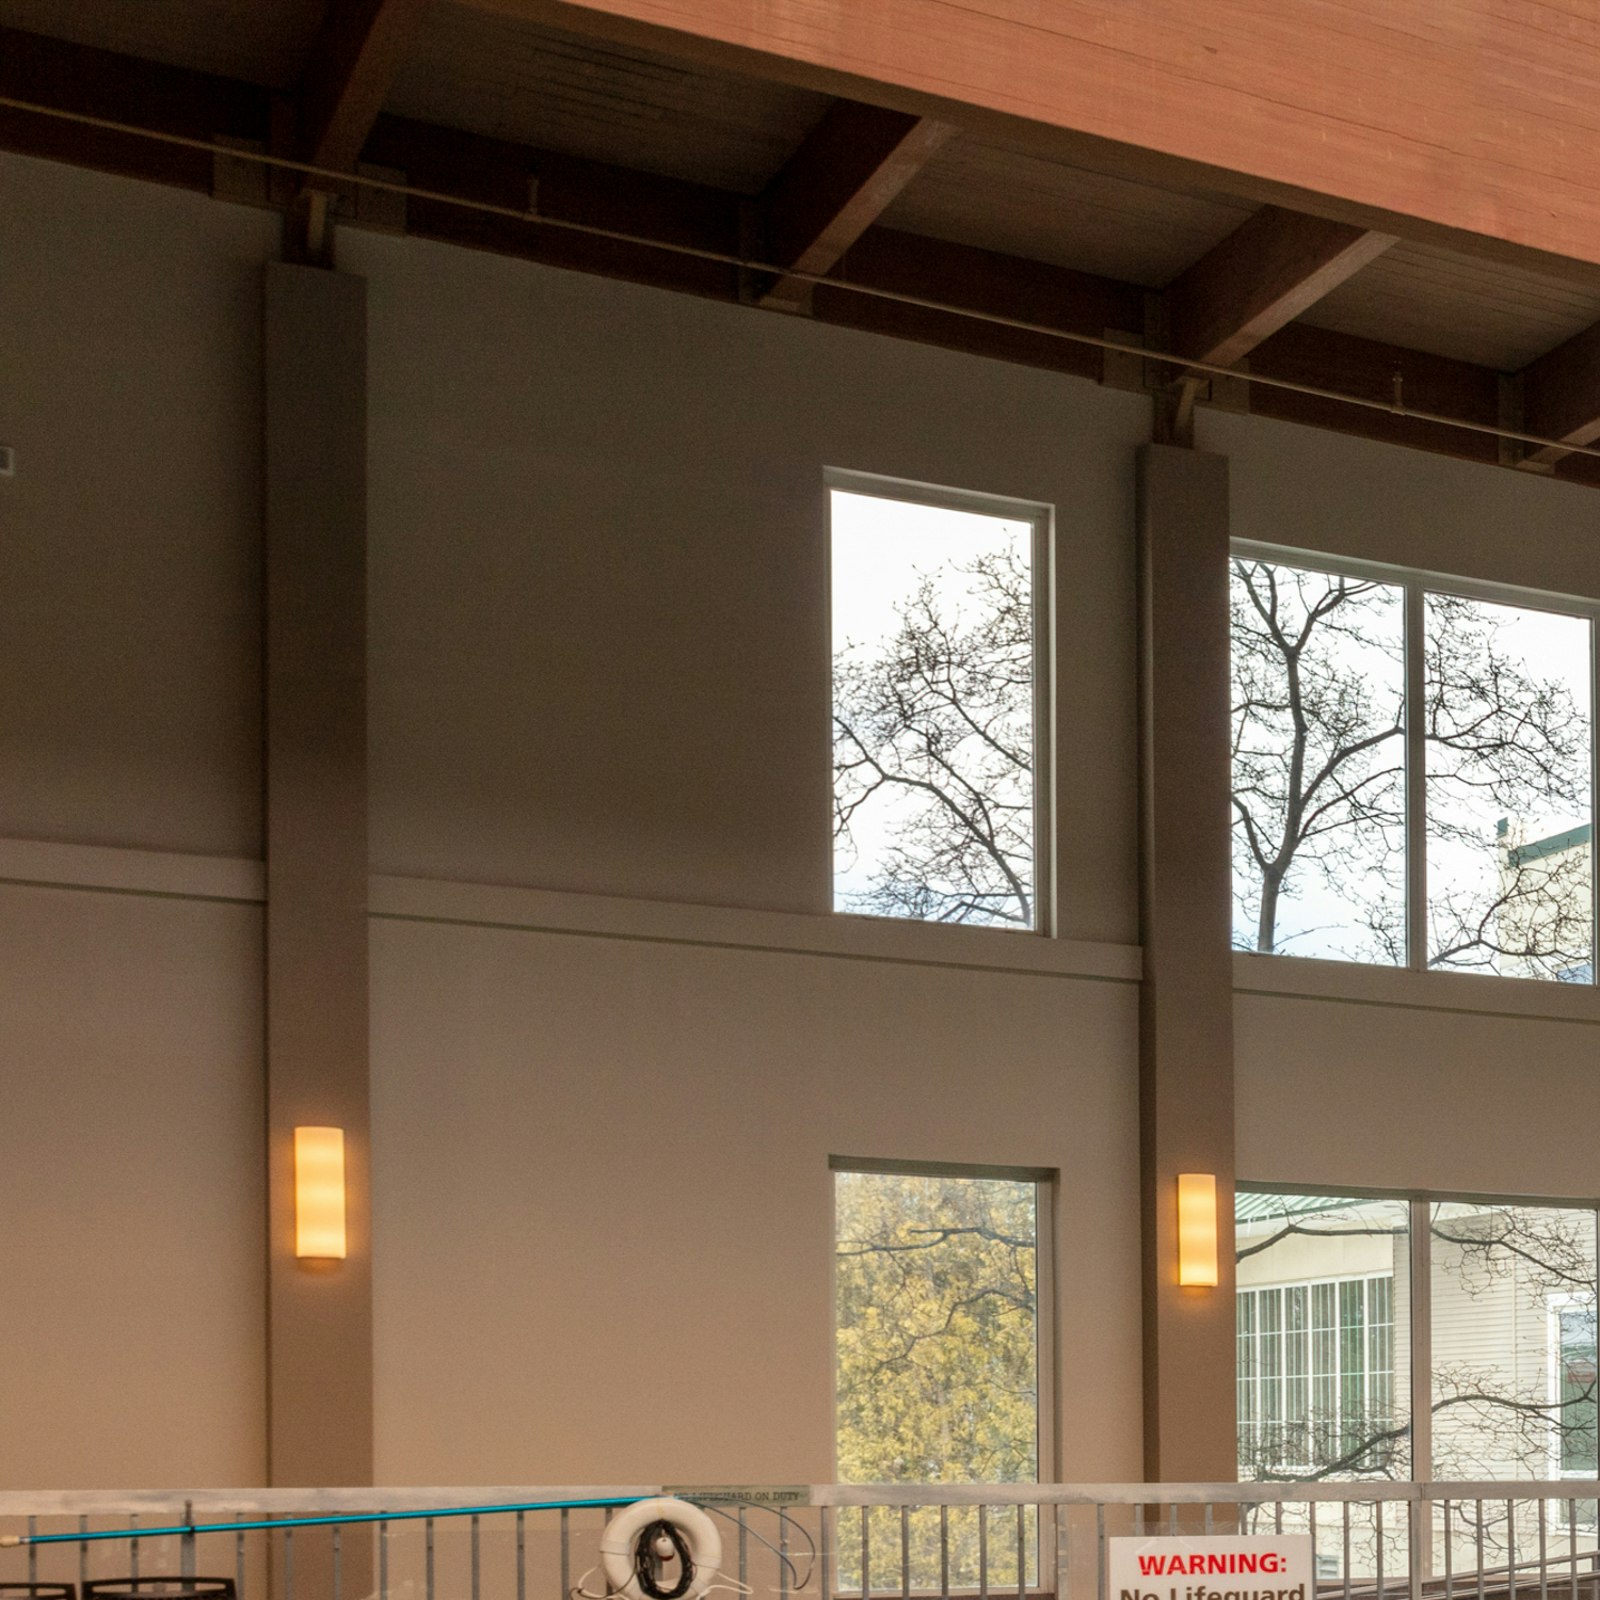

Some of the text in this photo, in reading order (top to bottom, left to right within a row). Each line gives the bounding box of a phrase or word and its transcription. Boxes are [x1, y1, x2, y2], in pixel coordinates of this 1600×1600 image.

[754, 1491, 770, 1501] ON
[773, 1491, 800, 1501] DUTY
[1138, 1553, 1287, 1576] WARNING:
